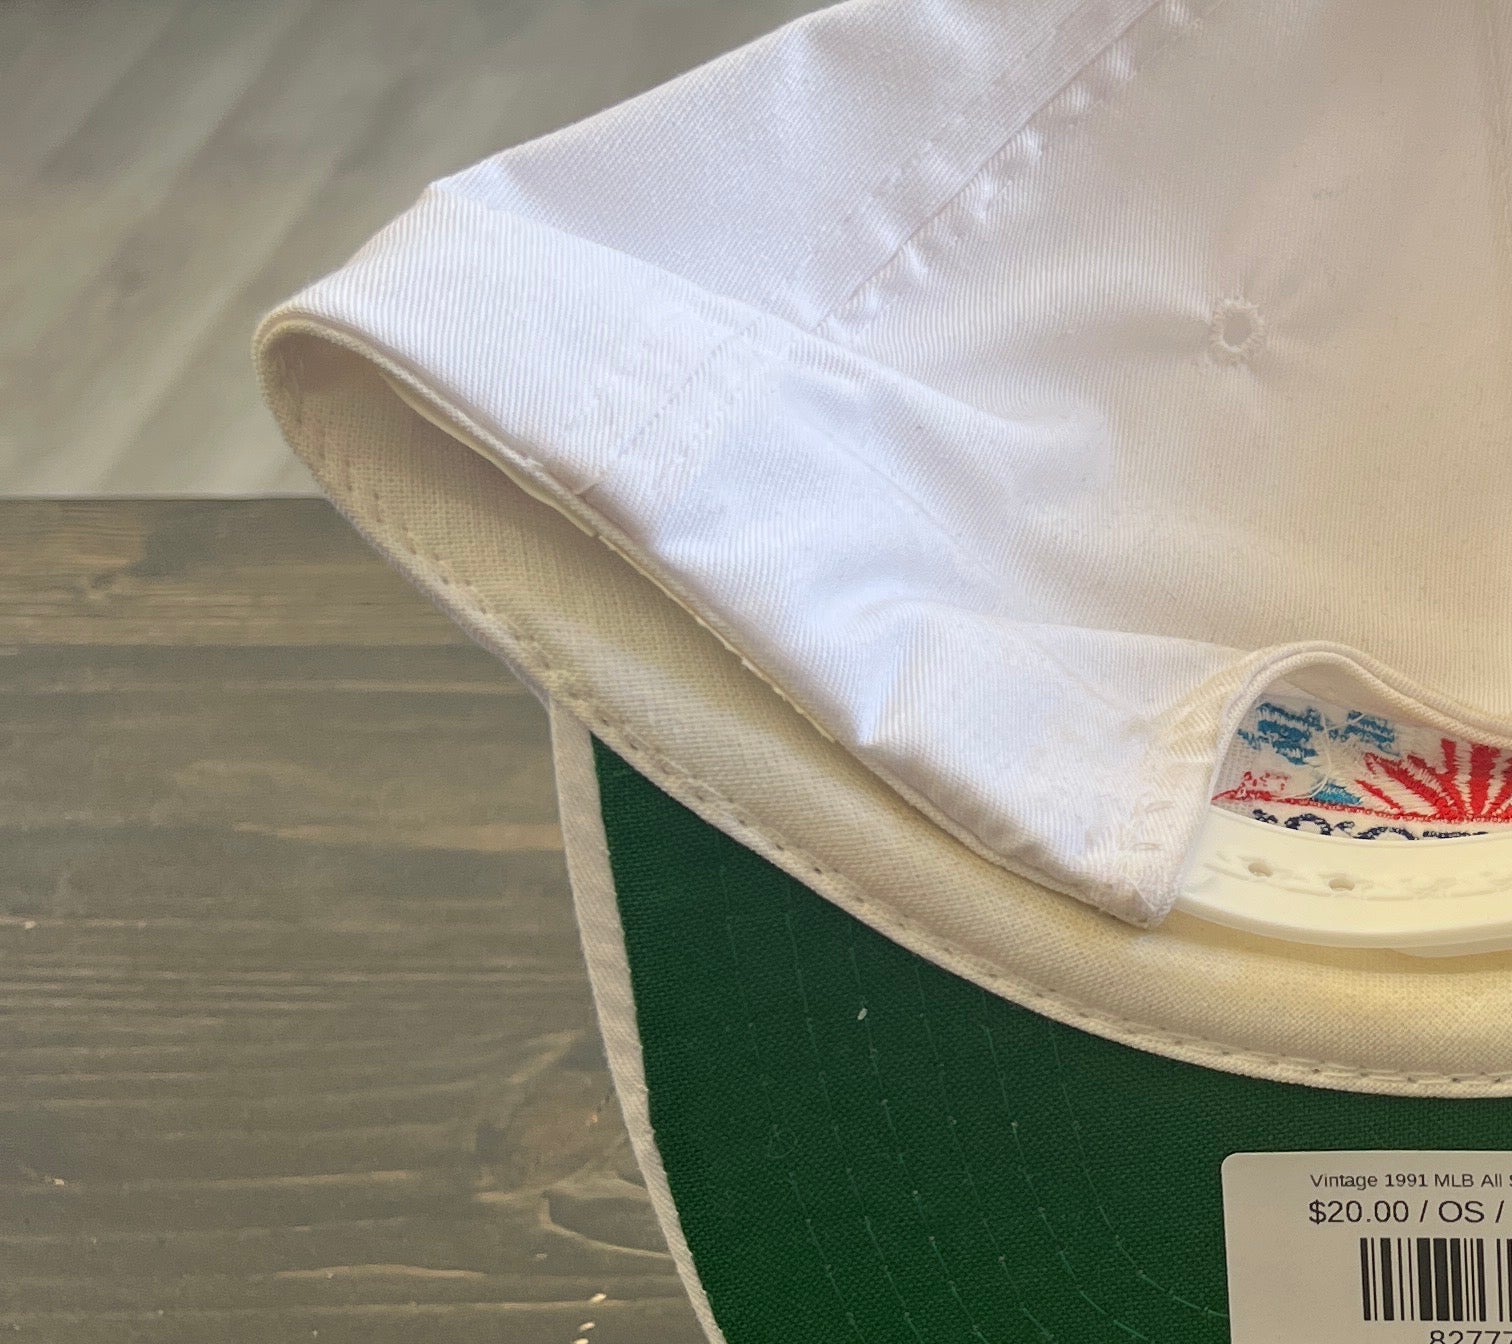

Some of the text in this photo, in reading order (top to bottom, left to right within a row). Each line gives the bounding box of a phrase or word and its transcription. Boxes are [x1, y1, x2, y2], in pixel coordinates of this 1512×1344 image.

[1309, 1173, 1378, 1191] Vintage
[1384, 1173, 1429, 1188] 1991
[1434, 1173, 1475, 1188] MLB
[1480, 1174, 1503, 1188] All
[1308, 1198, 1410, 1226] $20.00
[1419, 1199, 1429, 1223] /
[1438, 1200, 1485, 1224] OS
[1494, 1199, 1505, 1224] /
